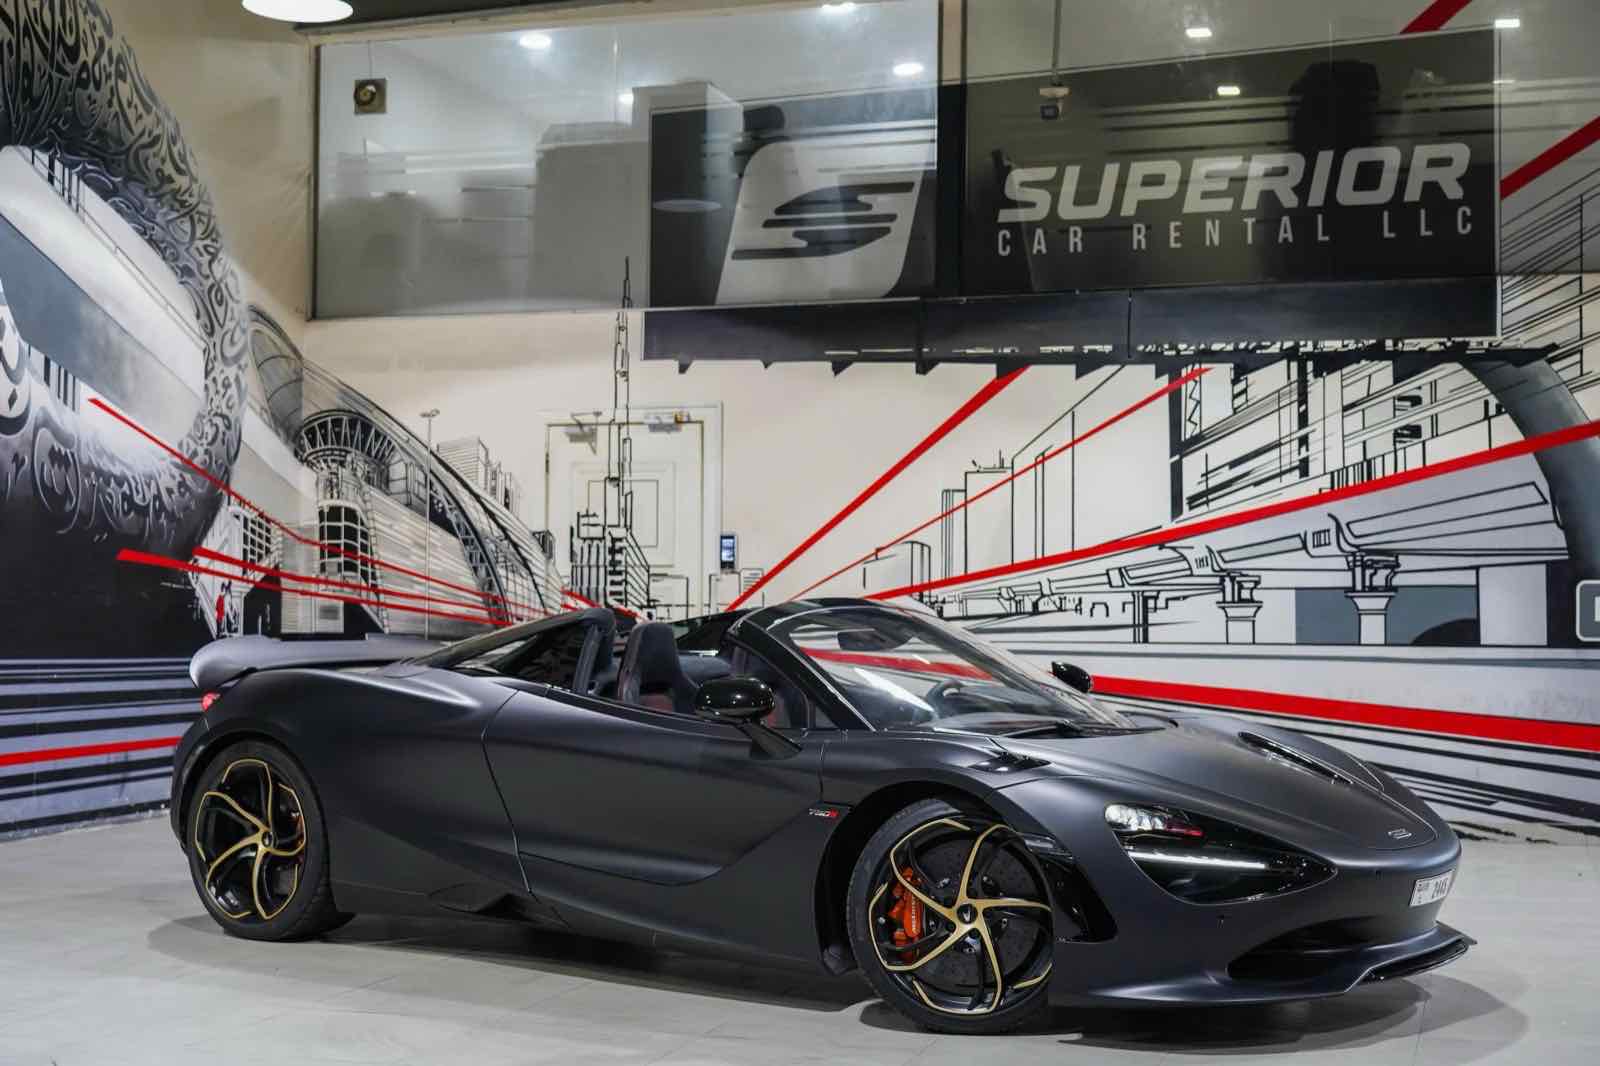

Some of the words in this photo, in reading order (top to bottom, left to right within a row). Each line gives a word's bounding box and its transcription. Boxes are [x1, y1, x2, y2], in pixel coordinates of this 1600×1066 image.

[997, 143, 1472, 223] SUPERIOR
[998, 226, 1082, 256] CAR
[1132, 214, 1330, 250] RENTAL
[1383, 206, 1473, 239] LLC
